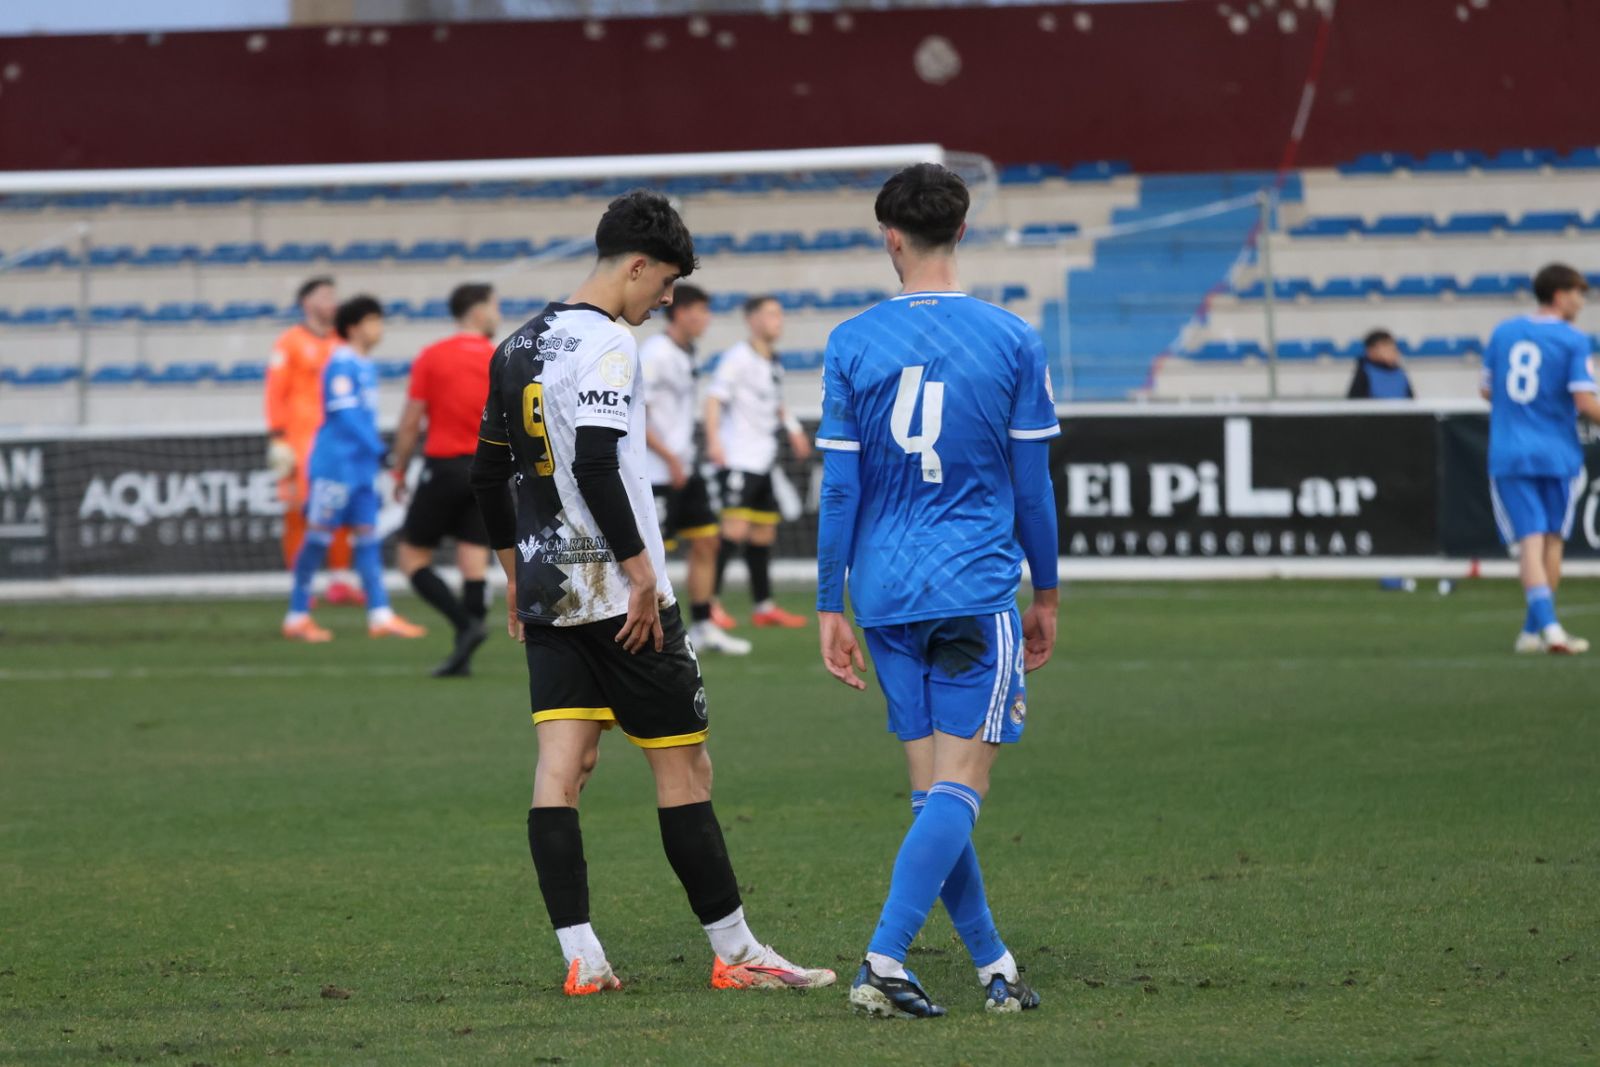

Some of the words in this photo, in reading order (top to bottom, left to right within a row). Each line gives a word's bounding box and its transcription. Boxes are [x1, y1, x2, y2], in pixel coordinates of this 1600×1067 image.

[516, 335, 533, 349] De
[1506, 339, 1542, 405] 8
[522, 382, 556, 477] 9
[577, 390, 619, 407] MMG
[890, 366, 944, 483] 4
[1065, 462, 1134, 517] El
[1149, 417, 1377, 517] PiLar
[1070, 530, 1374, 556] AUTOESCUELAS
